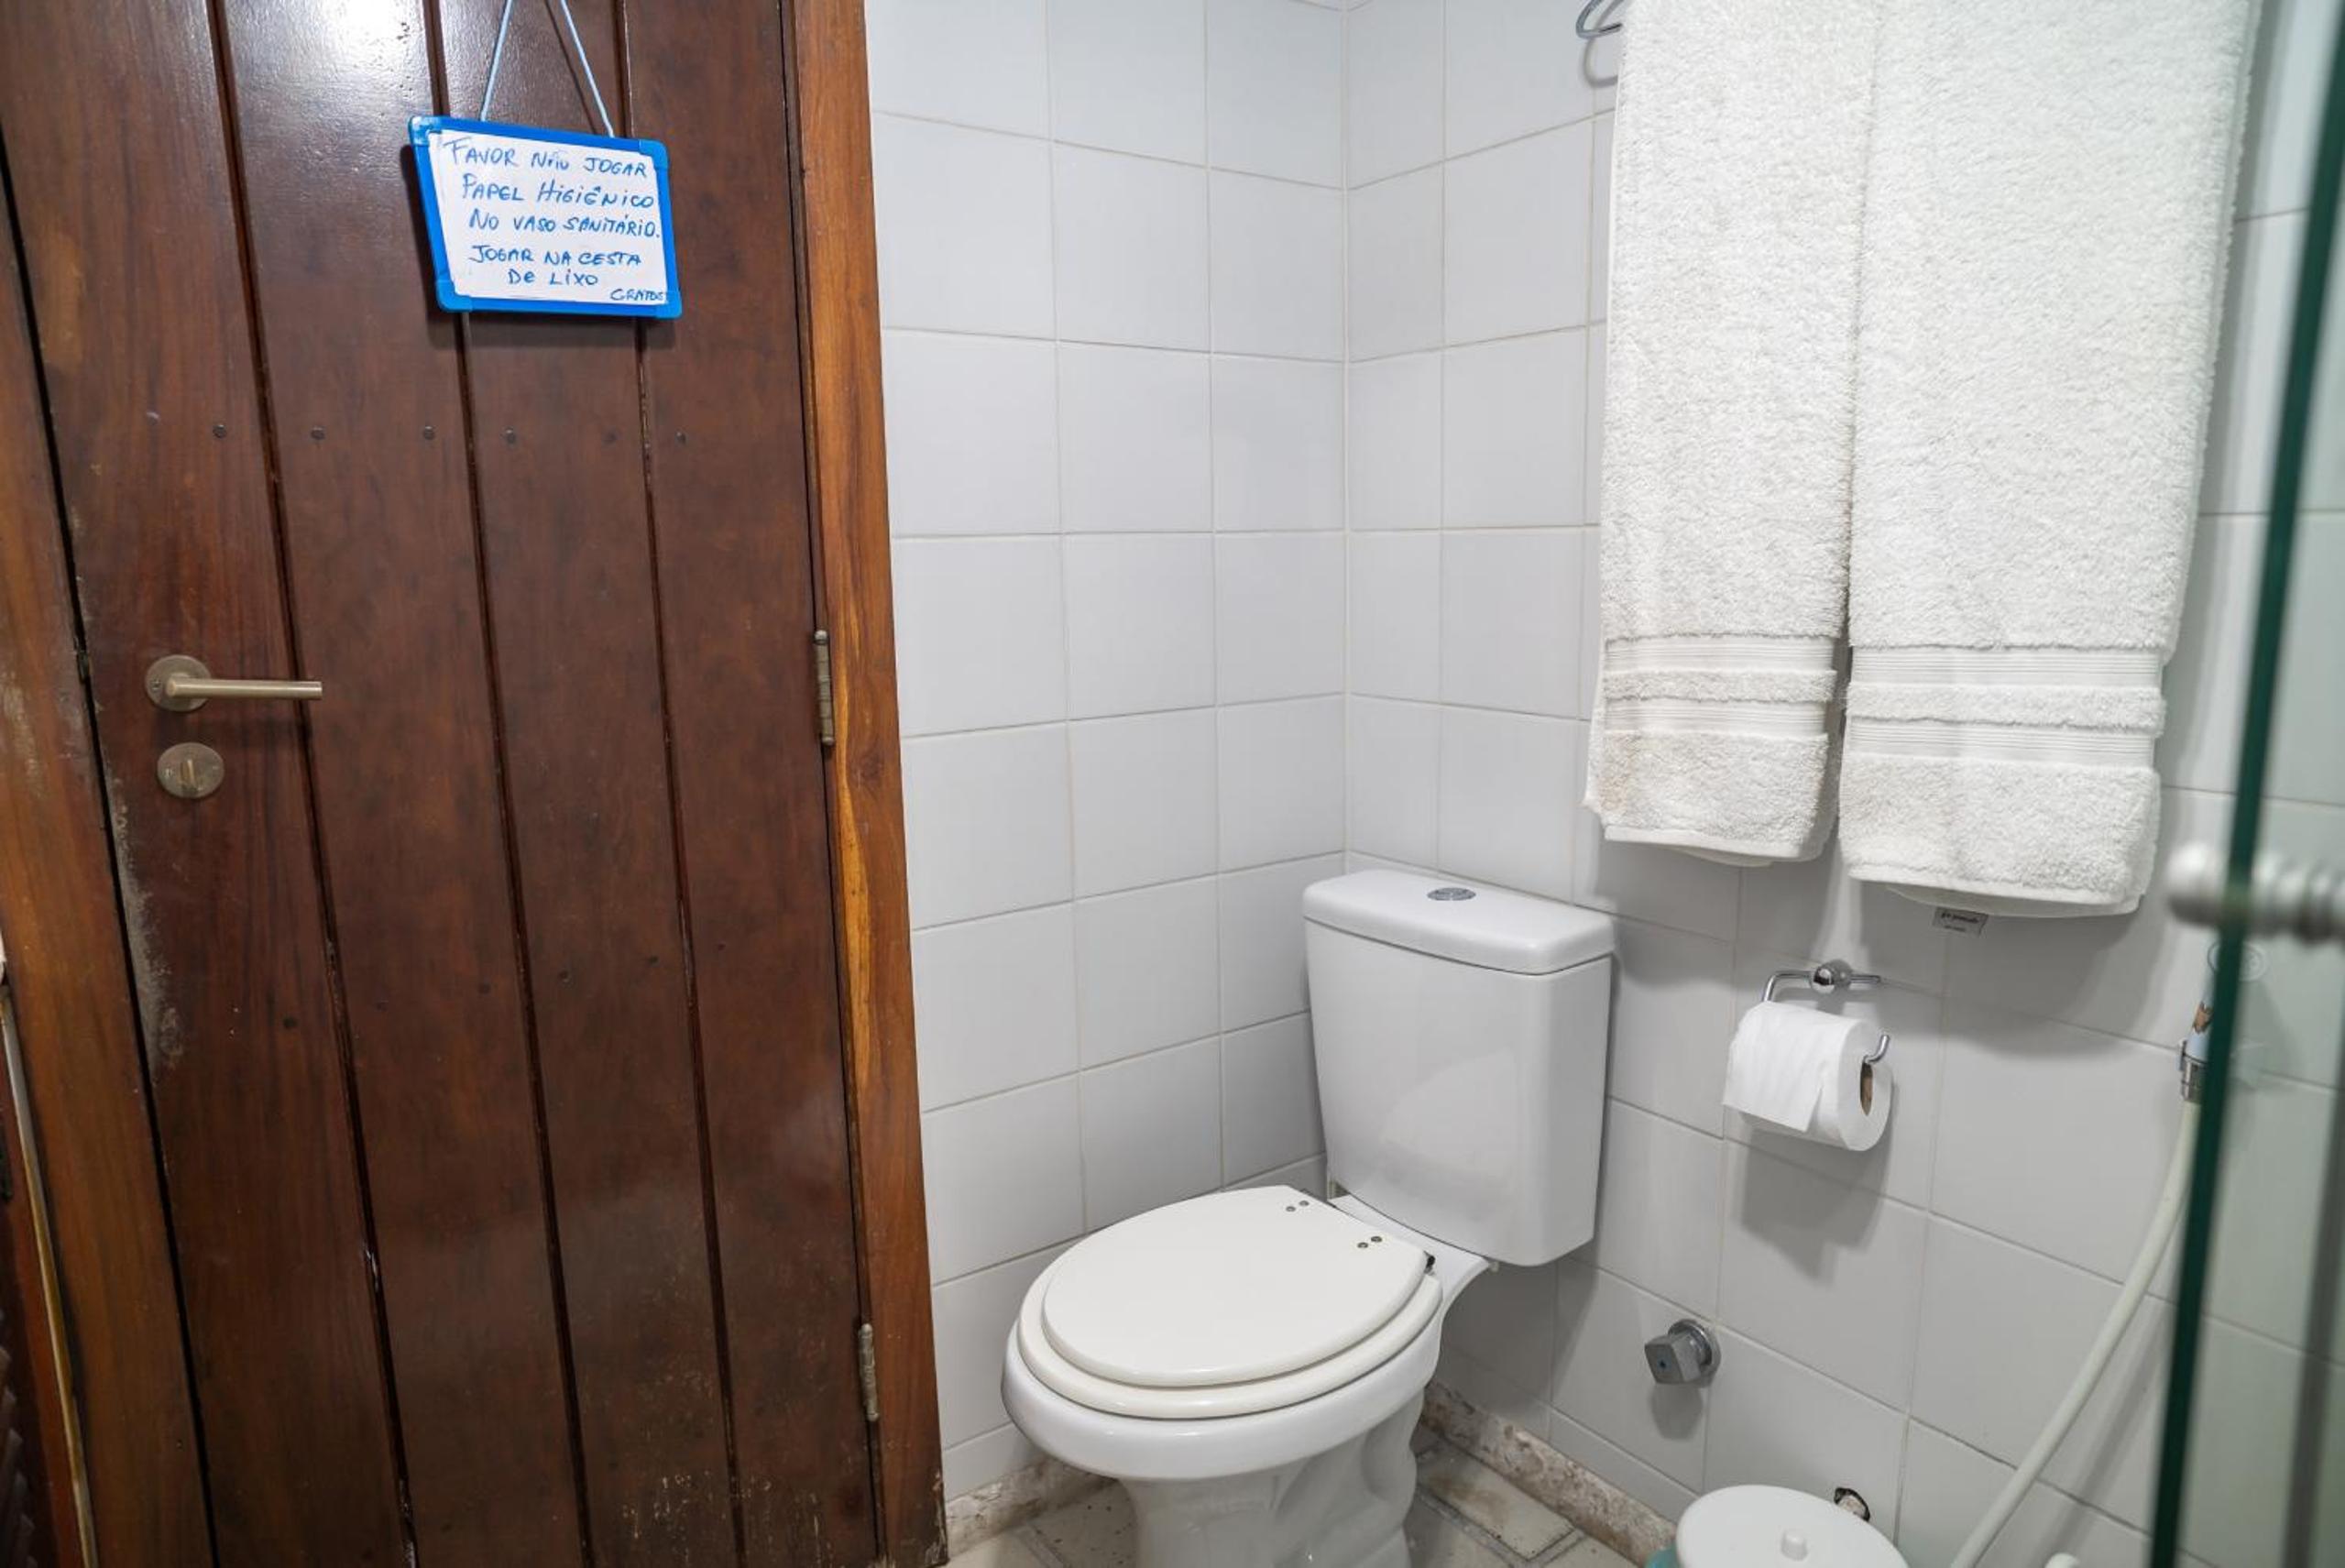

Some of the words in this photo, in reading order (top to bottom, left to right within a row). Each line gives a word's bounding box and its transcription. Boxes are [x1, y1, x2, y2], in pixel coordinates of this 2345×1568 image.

[443, 136, 519, 167] FAVOR
[583, 157, 647, 178] JOGAR
[463, 172, 524, 201] PAPEL
[468, 208, 499, 230] NO
[513, 215, 556, 232] VASO
[468, 245, 534, 263] JOGAR
[544, 251, 571, 266] NA
[578, 251, 641, 266] CESTA
